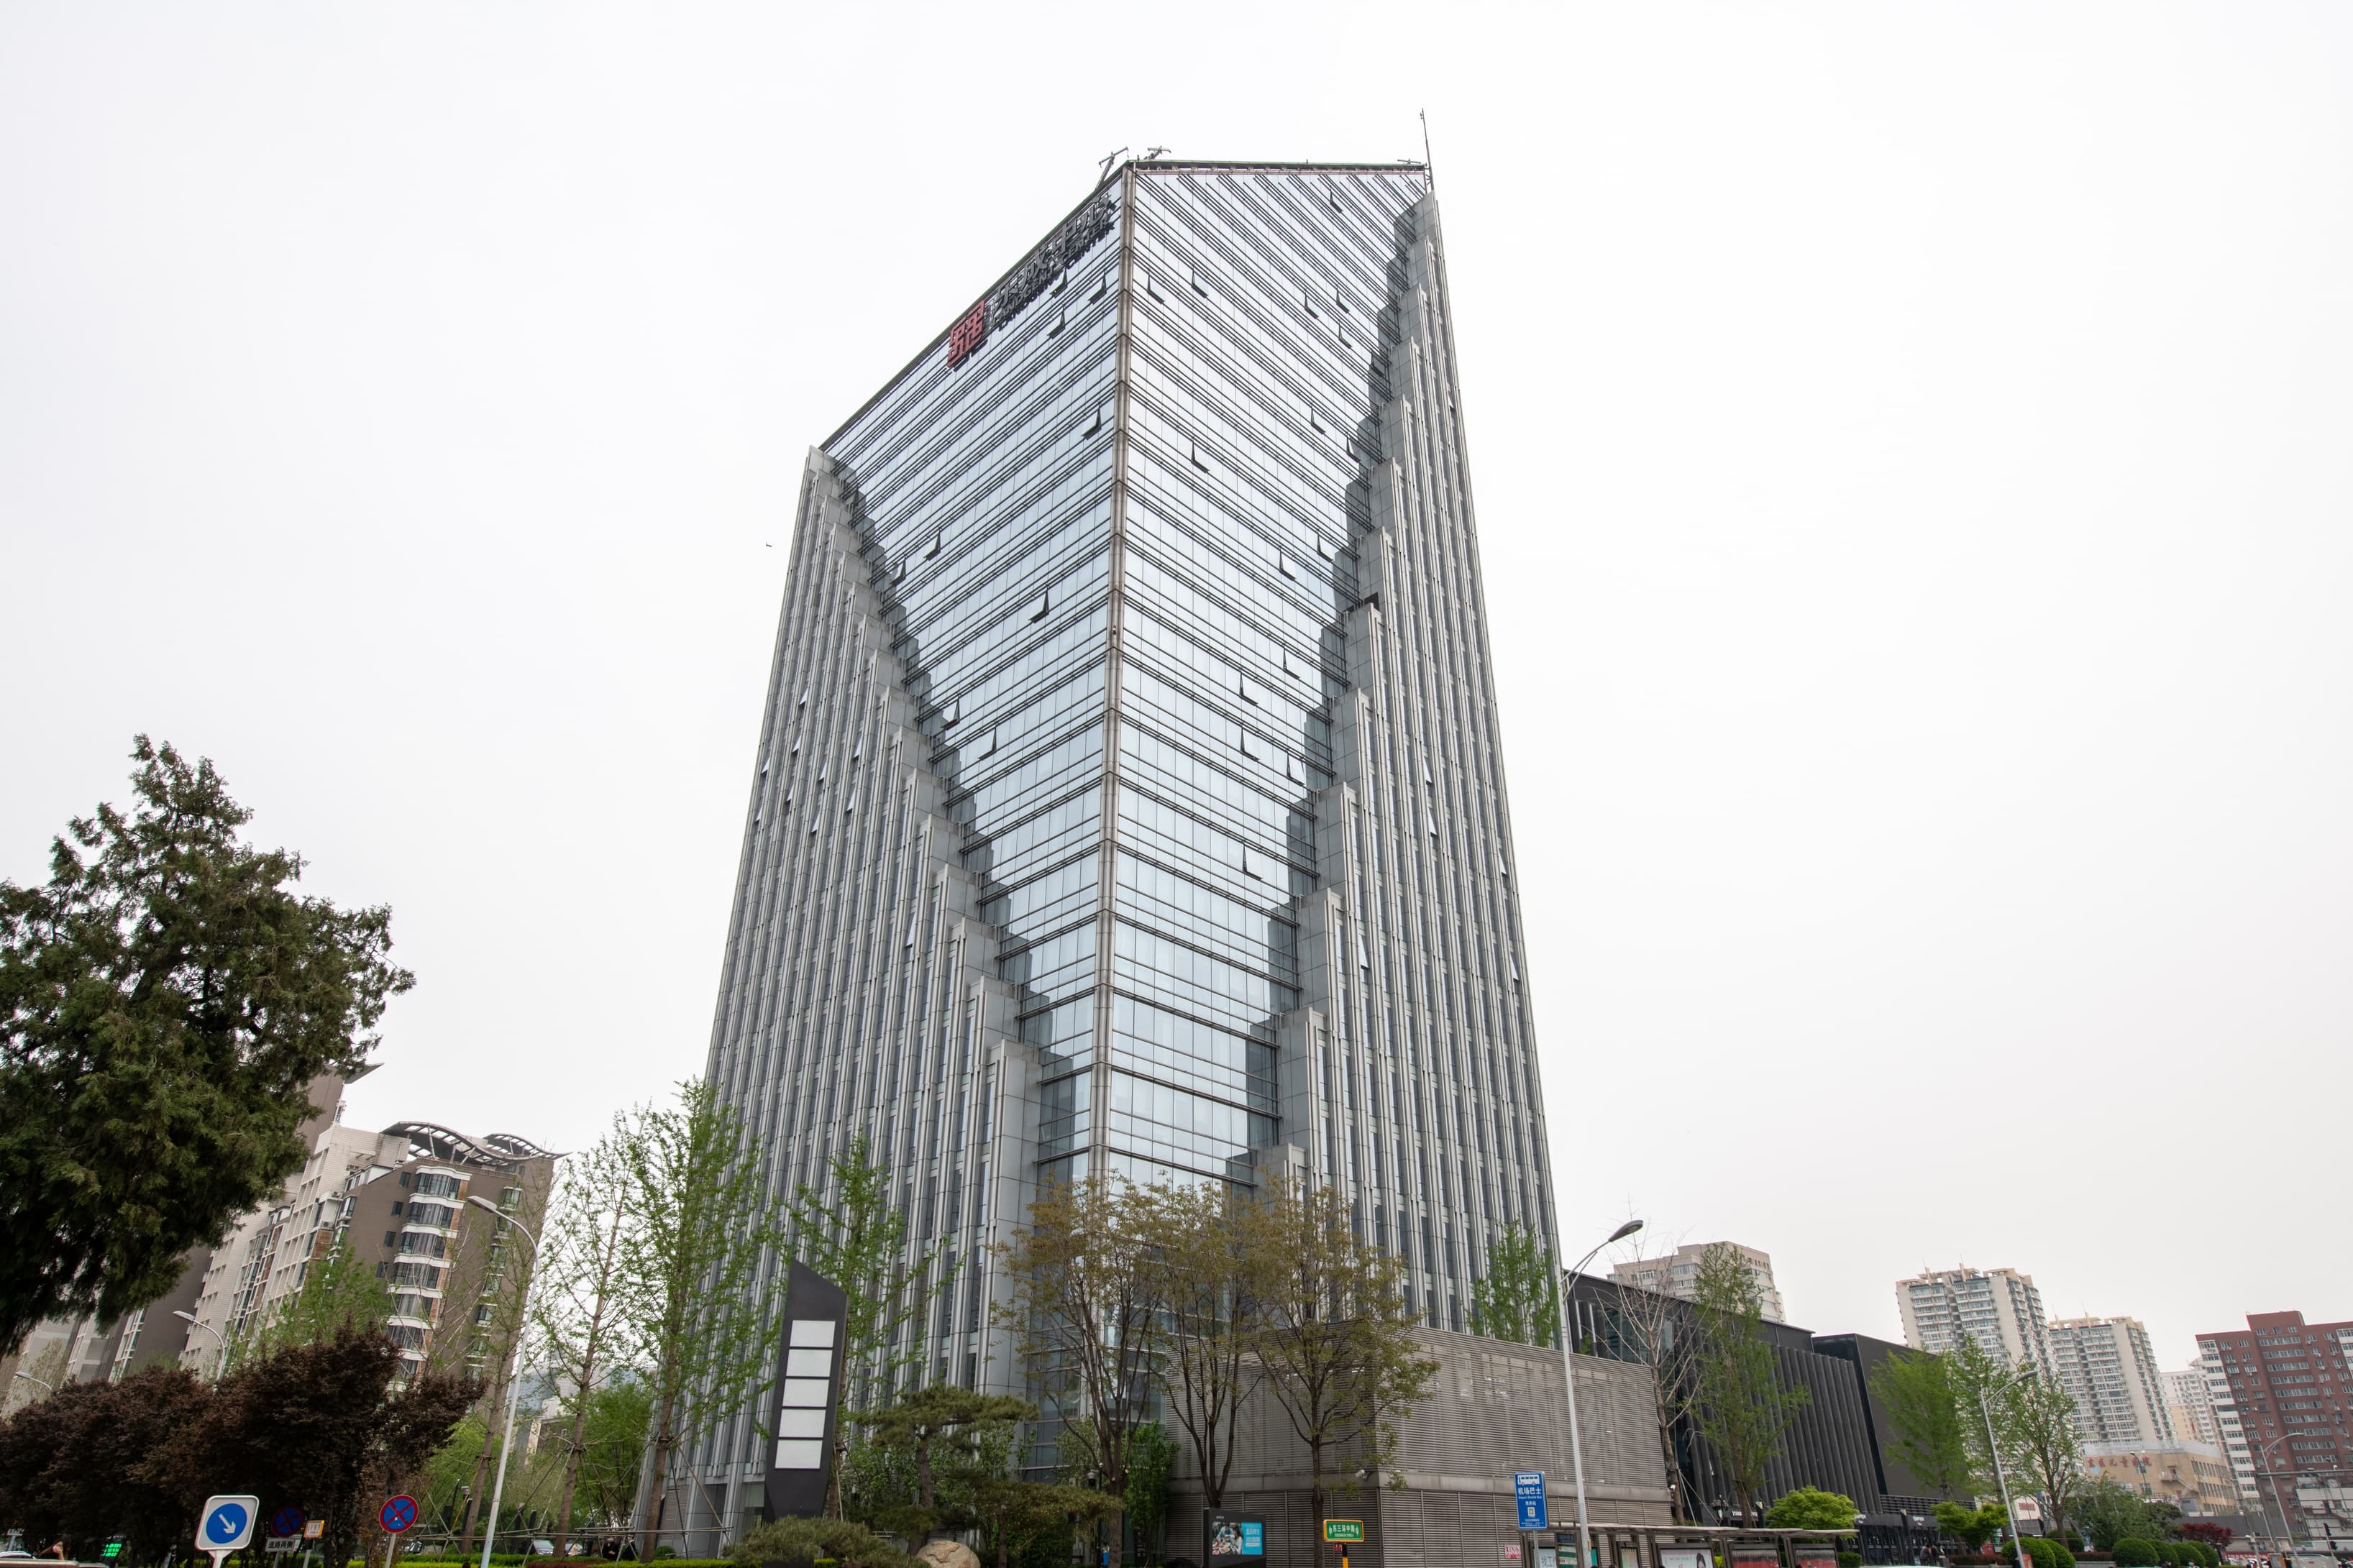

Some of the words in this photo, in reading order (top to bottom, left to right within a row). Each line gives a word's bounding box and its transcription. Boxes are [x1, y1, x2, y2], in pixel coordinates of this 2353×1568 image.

[993, 193, 1112, 314] 乐成中心
[1061, 211, 1110, 265] CENTER
[1518, 1486, 1542, 1495] 机场巴士
[1333, 1523, 1355, 1533] 东三环中路
